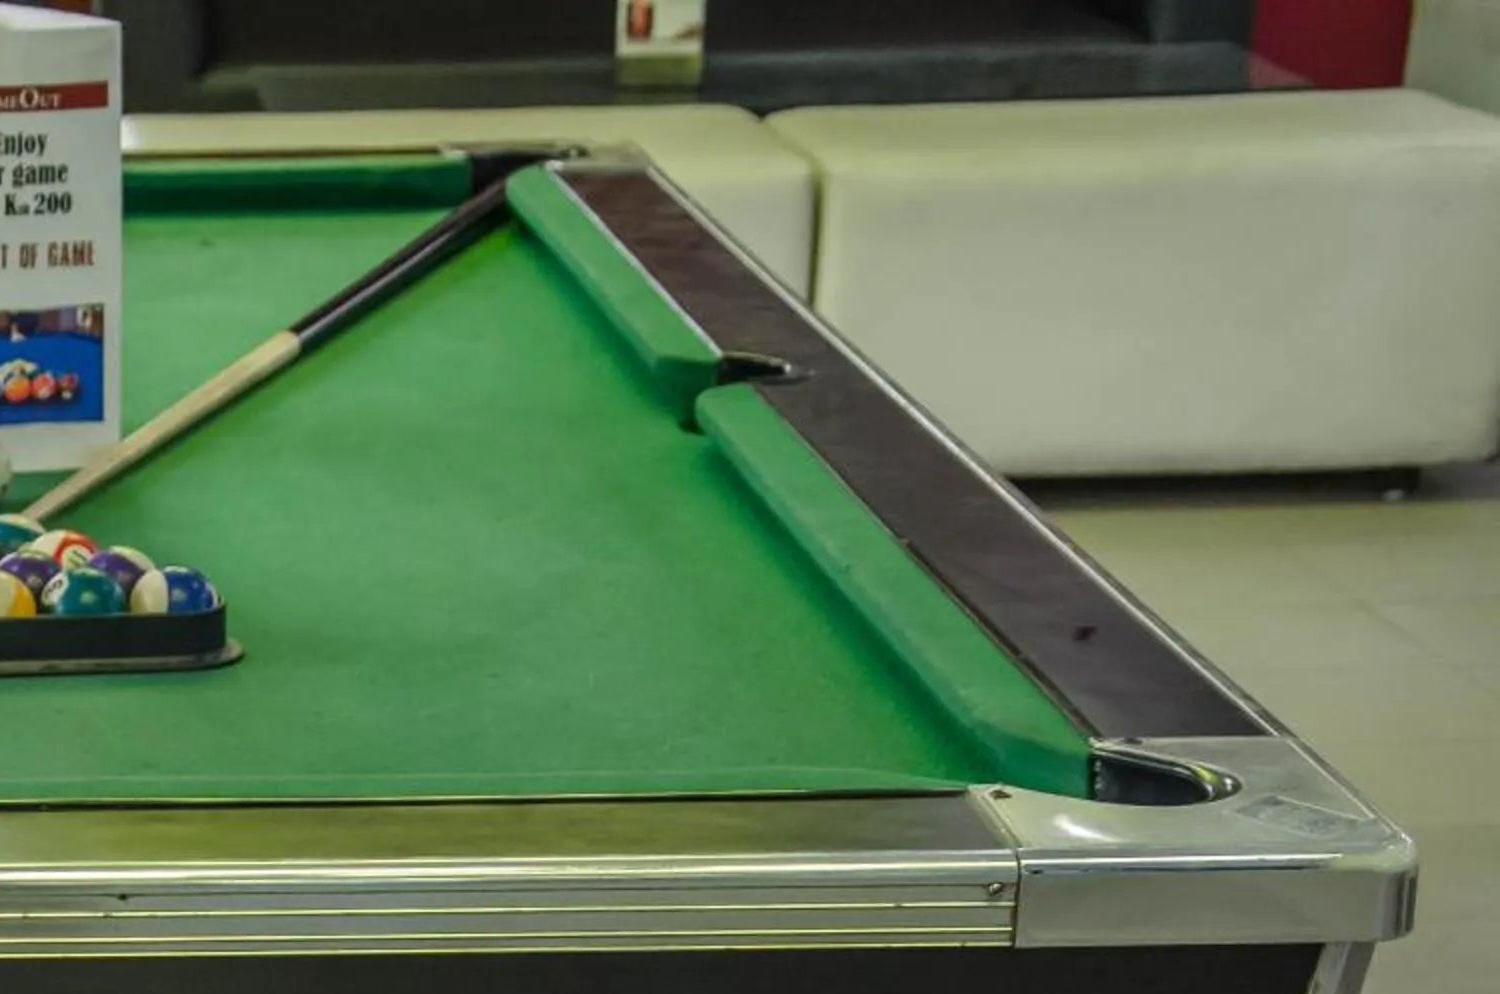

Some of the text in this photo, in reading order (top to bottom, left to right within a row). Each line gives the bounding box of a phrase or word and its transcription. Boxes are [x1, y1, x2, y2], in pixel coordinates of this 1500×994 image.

[11, 163, 68, 188] game
[33, 192, 72, 214] 200
[19, 243, 38, 268] OF
[48, 240, 94, 266] GAME
